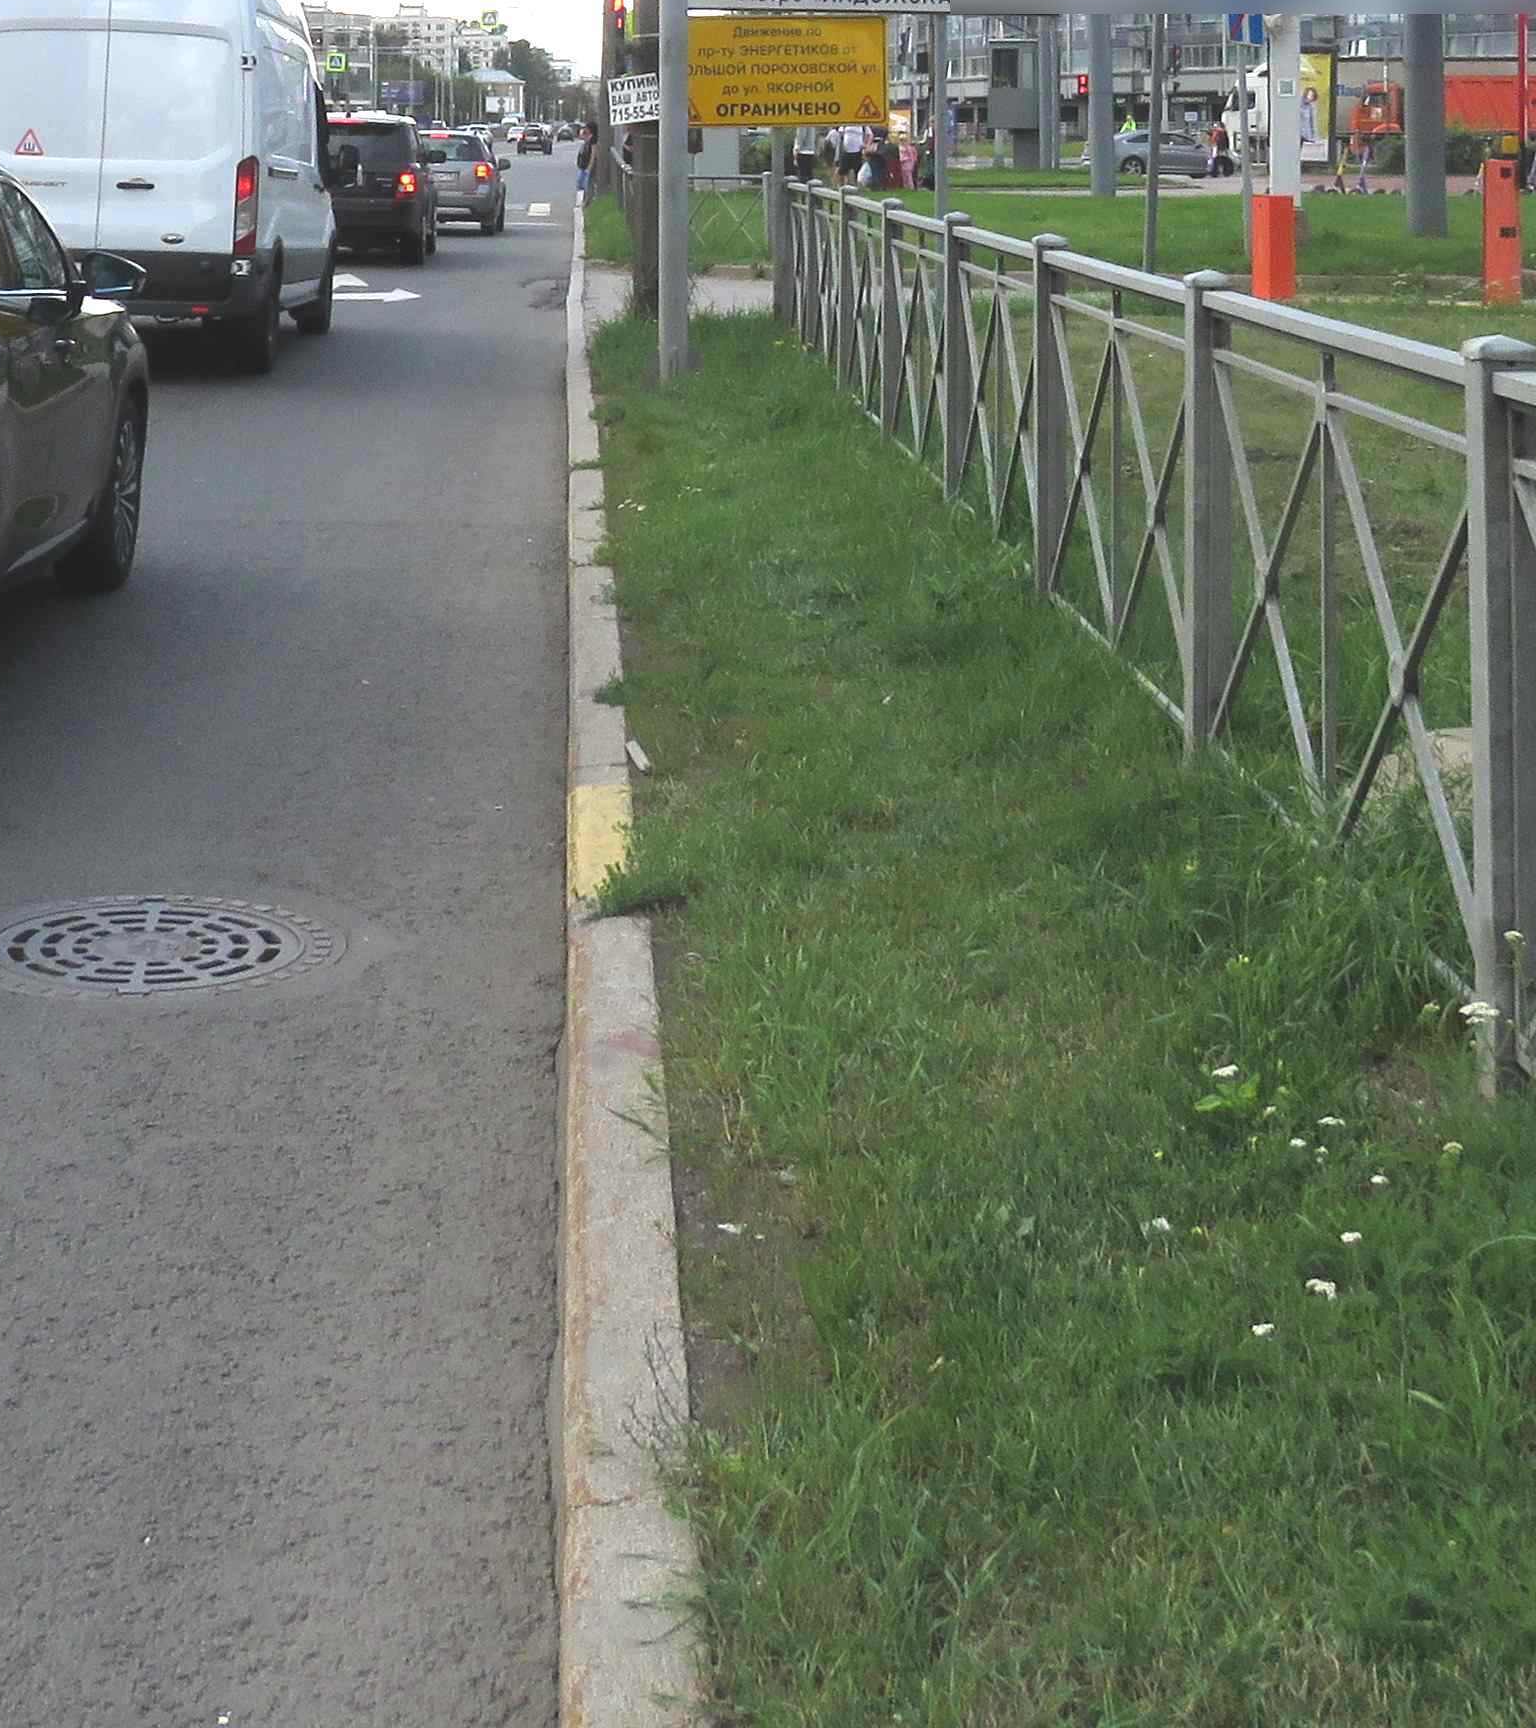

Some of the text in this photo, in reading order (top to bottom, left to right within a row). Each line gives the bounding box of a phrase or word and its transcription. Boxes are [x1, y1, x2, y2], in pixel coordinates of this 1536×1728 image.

[732, 26, 802, 39] Движение
[698, 46, 735, 58] пр-ту
[739, 44, 838, 56] ЭНЕРГЕТИКОВ
[688, 62, 746, 77] ОЛЬШОЙ
[751, 61, 858, 75] ПОРОХОВСКОЙ
[610, 76, 657, 92] КУПИМ
[722, 85, 739, 96] до
[766, 81, 835, 93] ЯКОРНОЙ
[612, 90, 660, 106] ВАШ АВТО
[612, 104, 660, 122] 715-55-45
[716, 102, 841, 117] ОГРАНИЧЕНО
